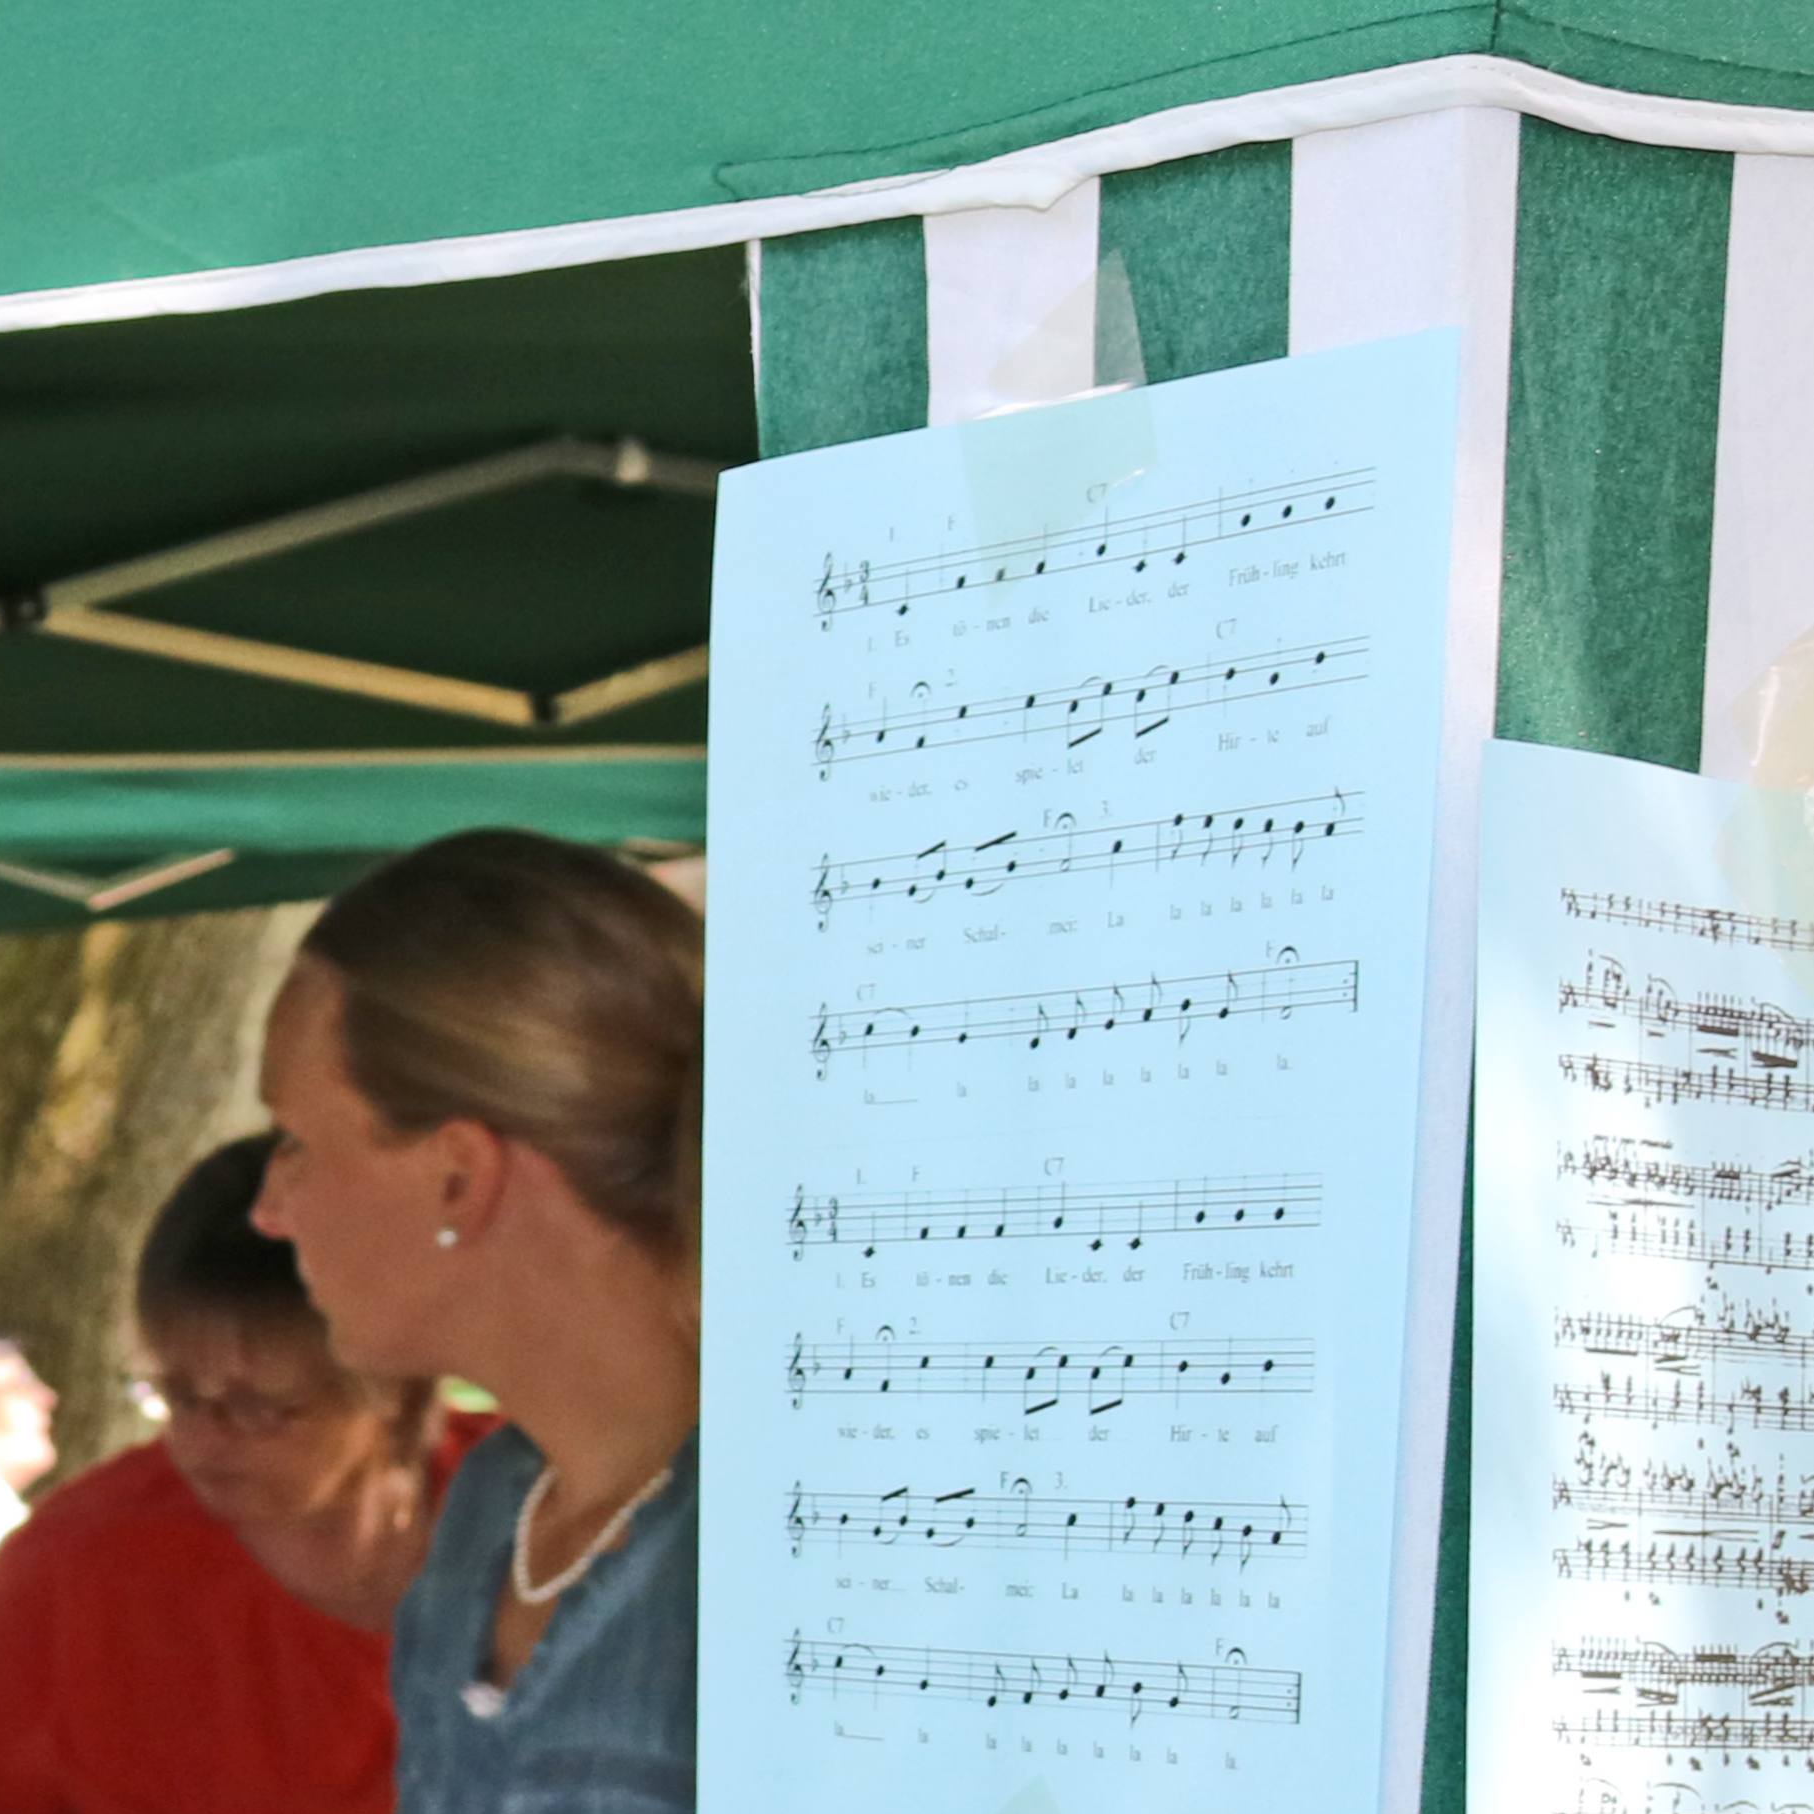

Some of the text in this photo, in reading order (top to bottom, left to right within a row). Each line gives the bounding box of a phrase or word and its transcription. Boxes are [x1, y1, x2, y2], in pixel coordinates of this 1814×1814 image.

[1087, 484, 1108, 503] C7
[1169, 582, 1190, 599] der
[1310, 552, 1346, 570] kehrt
[1216, 619, 1238, 640] C7
[1134, 749, 1156, 765] der
[1307, 717, 1330, 737] auf
[1043, 809, 1051, 827] F
[1108, 913, 1124, 928] La
[857, 984, 875, 1000] C7
[912, 1165, 921, 1182] F
[1045, 1157, 1064, 1176] C7
[988, 1269, 1007, 1285] die
[1123, 1267, 1144, 1283] der
[1261, 1261, 1294, 1279] kehrt
[1170, 1311, 1190, 1330] C7
[1089, 1424, 1110, 1441] der
[1171, 1424, 1192, 1442] Hir
[1255, 1425, 1280, 1444] auf
[1000, 1471, 1009, 1488] F
[1062, 1582, 1078, 1600] La
[1123, 1585, 1133, 1601] la
[1152, 1586, 1163, 1602] la
[1181, 1588, 1192, 1604] la
[1211, 1590, 1221, 1606] la
[1239, 1591, 1250, 1607] la
[1269, 1592, 1280, 1608] la
[827, 1617, 1224, 1656] C7 F
[918, 1728, 928, 1743] la
[987, 1734, 997, 1749] la
[1022, 1736, 1032, 1751] la
[1058, 1739, 1067, 1755] la
[1094, 1742, 1104, 1758] la
[1131, 1745, 1141, 1762] la
[1167, 1748, 1178, 1764] la
